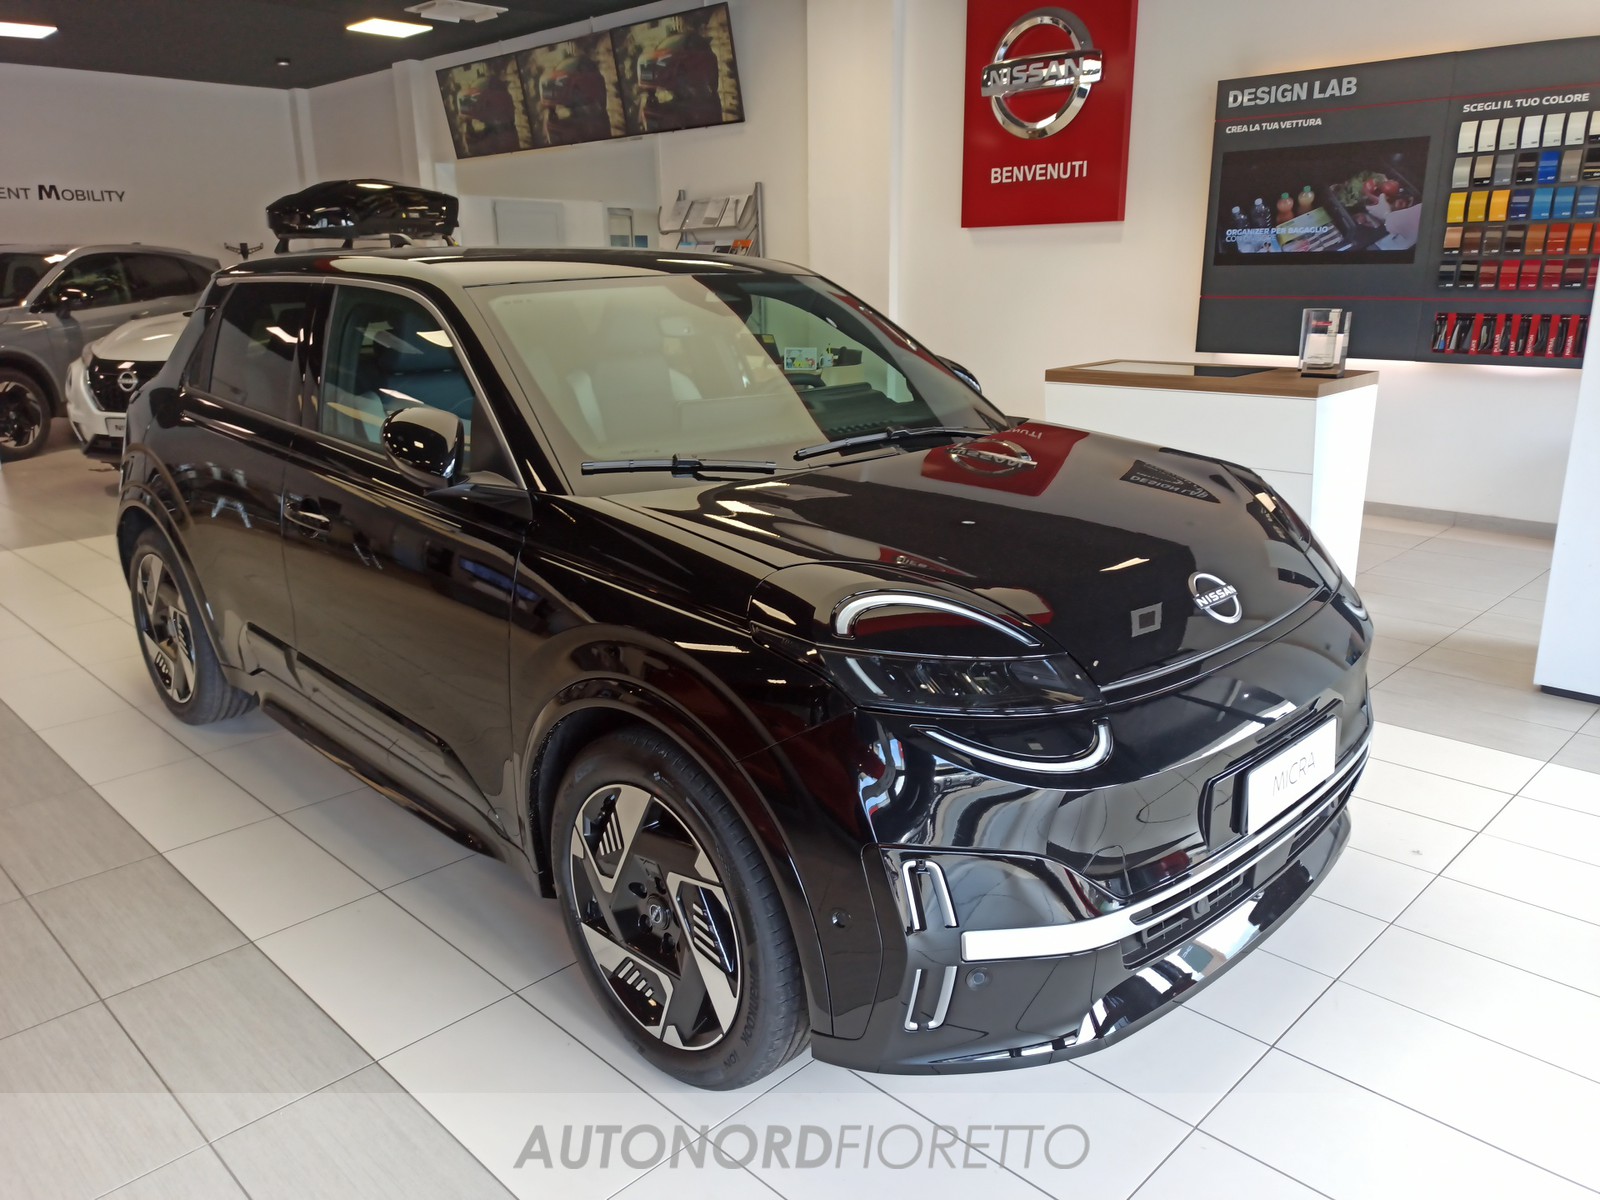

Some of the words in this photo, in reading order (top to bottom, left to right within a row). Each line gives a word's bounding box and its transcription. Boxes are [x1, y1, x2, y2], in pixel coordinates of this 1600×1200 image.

[990, 57, 1085, 88] NISSAN
[1227, 81, 1307, 109] DESIGN
[1313, 76, 1358, 100] LAB
[1463, 100, 1502, 113] SCEGLI
[1503, 99, 1513, 109] IL
[1515, 97, 1539, 108] TUO
[1542, 92, 1590, 105] COLORE
[1225, 122, 1248, 134] CREA
[1249, 122, 1260, 132] LA
[1260, 120, 1279, 131] TUA
[1280, 117, 1322, 129] VETTURA
[990, 160, 1088, 184] BENVENUTI
[1226, 227, 1270, 236] ORGANIZER
[1271, 226, 1286, 235] PER
[1288, 225, 1329, 235] BAGAGLIO
[1196, 584, 1238, 609] NISSAN
[1272, 752, 1316, 797] MICRA
